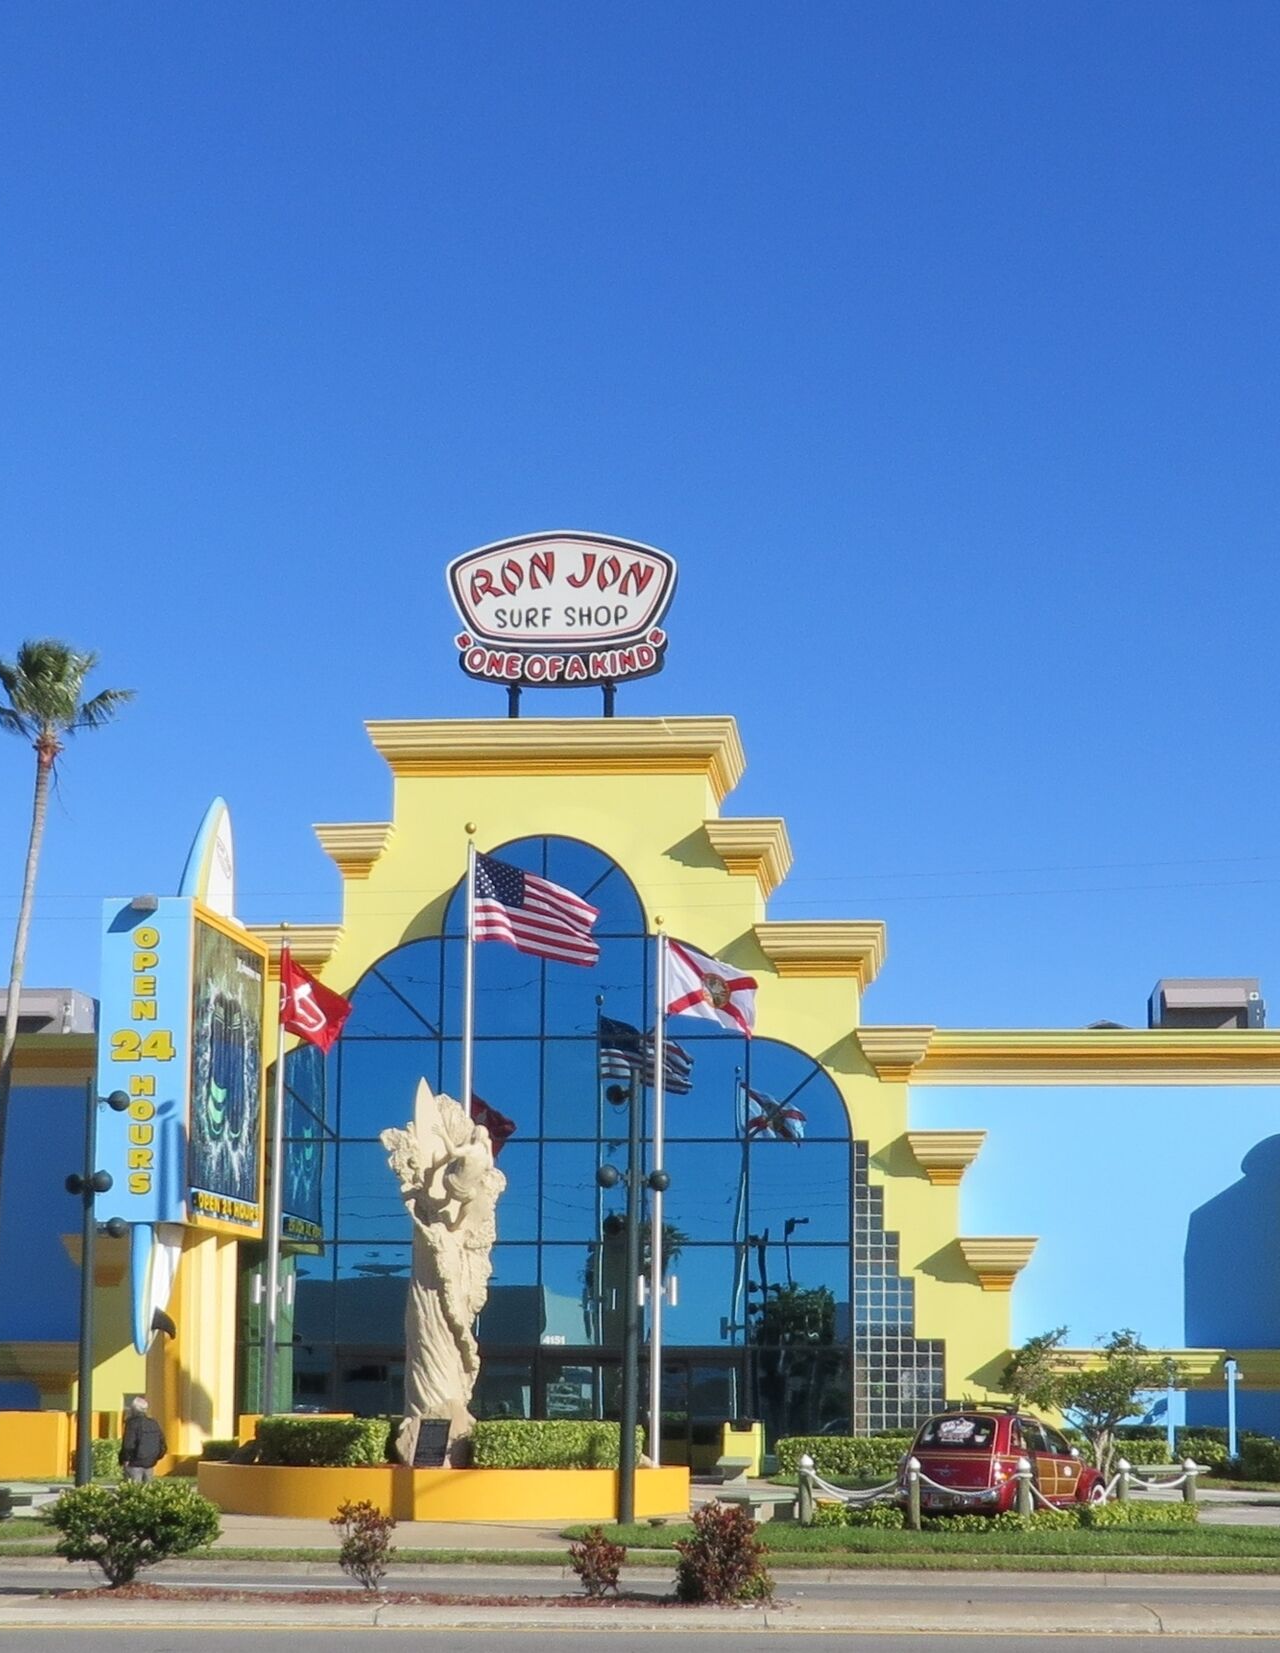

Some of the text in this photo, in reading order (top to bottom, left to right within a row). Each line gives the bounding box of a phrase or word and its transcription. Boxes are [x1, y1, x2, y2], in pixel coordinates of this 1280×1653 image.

[470, 551, 655, 607] RON JON
[494, 605, 628, 629] SURF SHOP
[527, 655, 564, 680] OF
[569, 656, 587, 679] A
[132, 926, 160, 1021] OPEN
[110, 1029, 176, 1062] 24
[128, 1074, 156, 1195] HOURS
[542, 1335, 566, 1345] 4151
